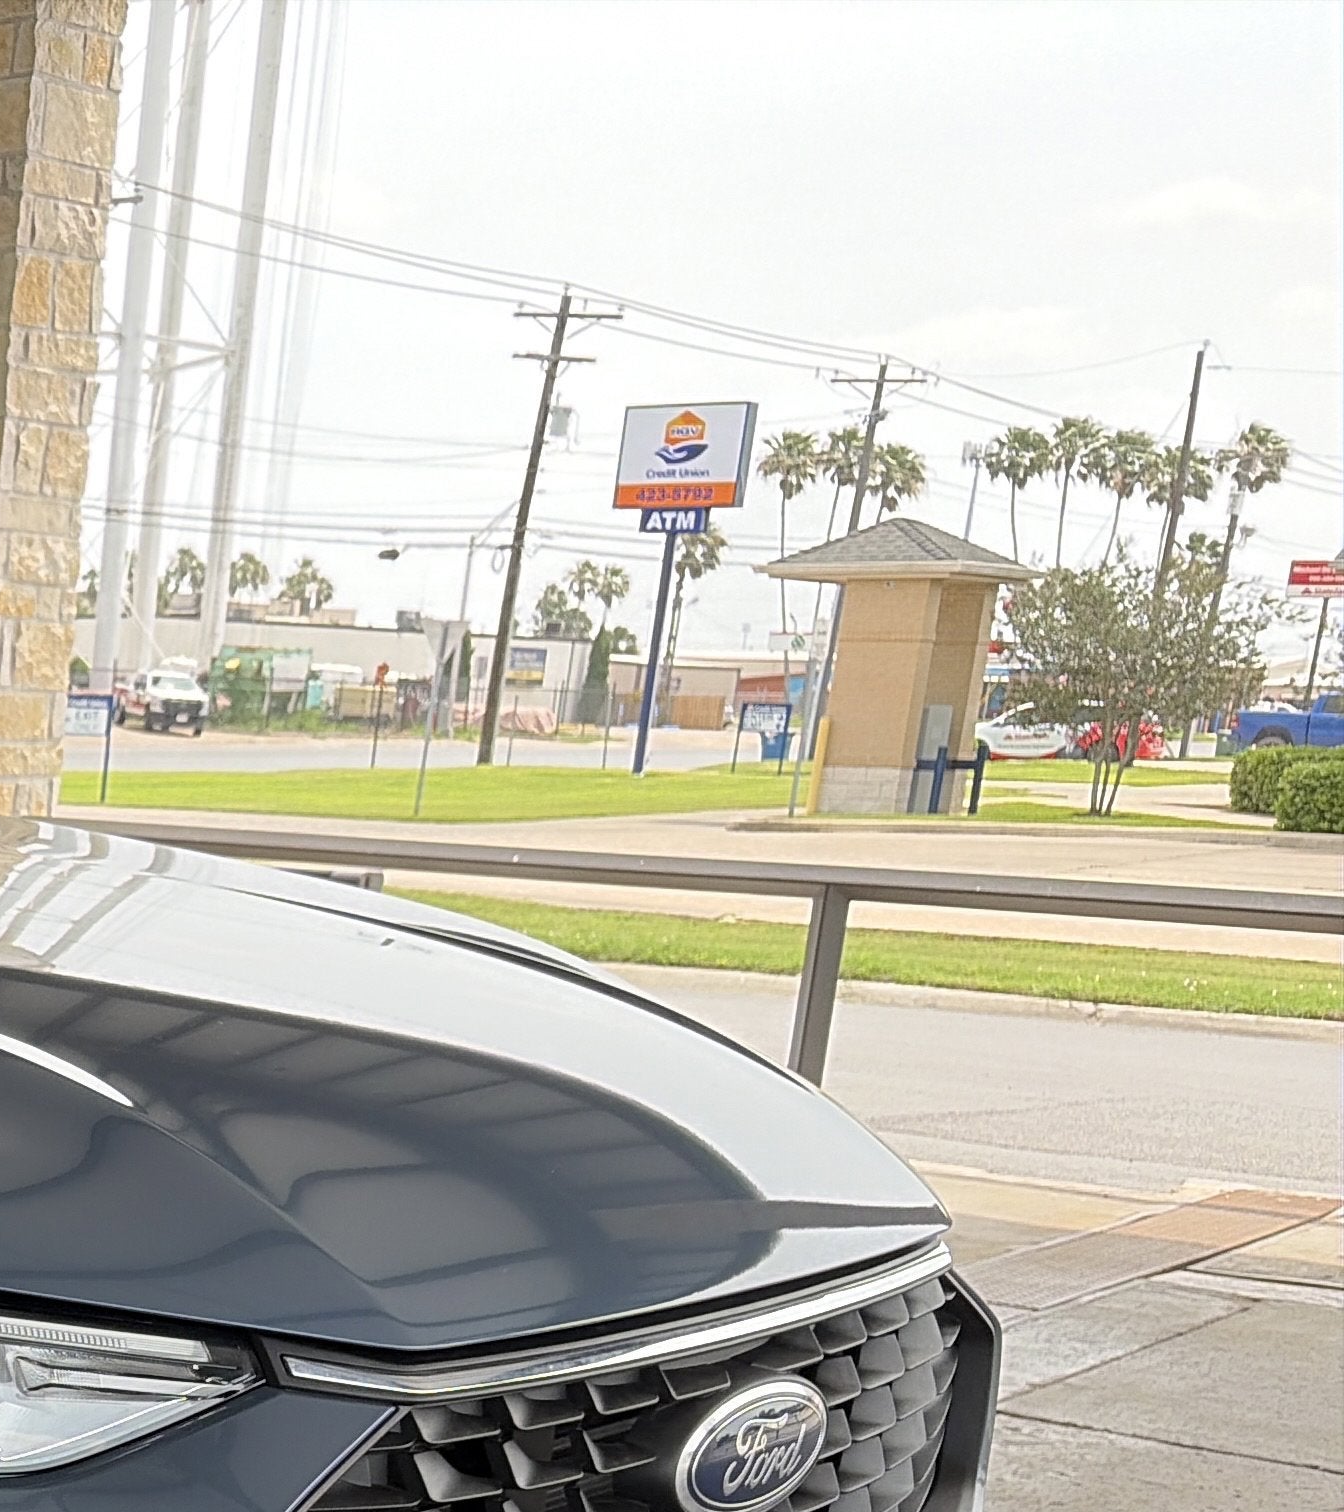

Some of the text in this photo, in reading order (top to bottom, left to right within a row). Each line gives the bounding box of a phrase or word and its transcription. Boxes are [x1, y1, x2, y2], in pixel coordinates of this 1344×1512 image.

[645, 468, 710, 479] Credit Union
[645, 510, 696, 531] ATM
[723, 1413, 806, 1496] Ford
